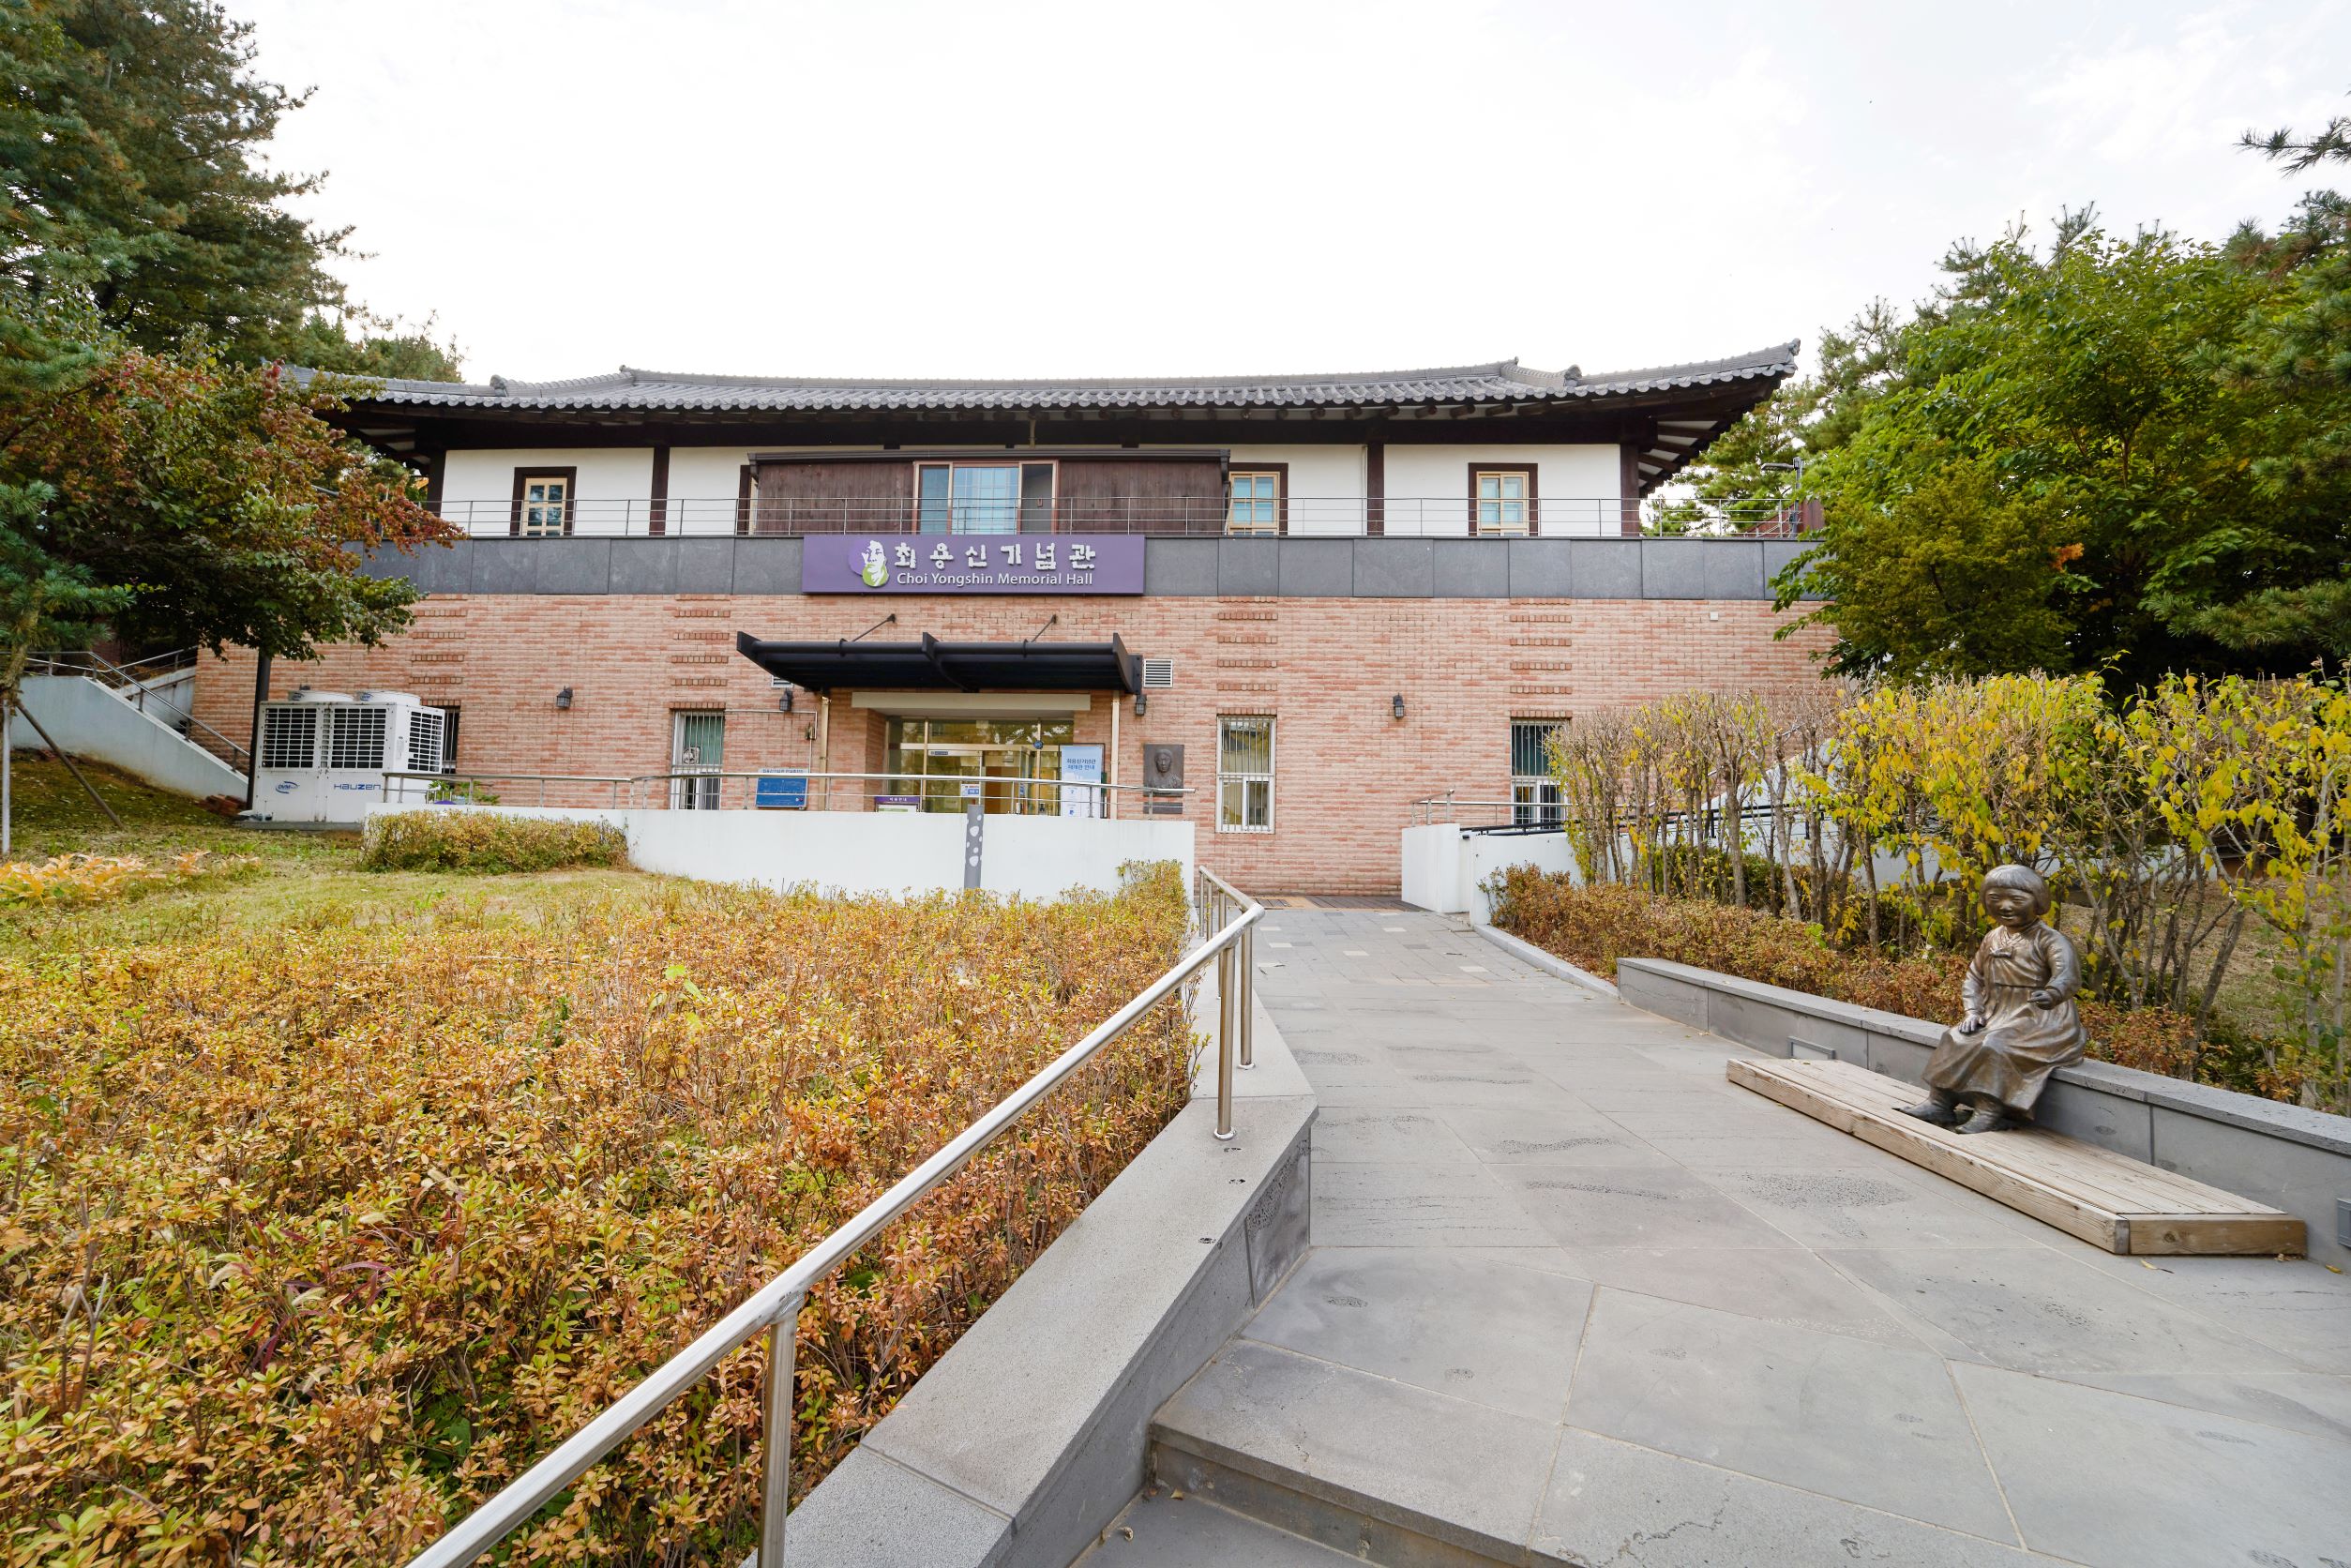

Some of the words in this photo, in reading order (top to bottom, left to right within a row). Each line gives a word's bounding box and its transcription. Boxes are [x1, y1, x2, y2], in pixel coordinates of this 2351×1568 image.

[895, 542, 1096, 570] 최용신기념관
[897, 572, 927, 585] Choi
[931, 572, 993, 588] Yongshin
[998, 573, 1062, 586] Memorial
[1066, 573, 1093, 585] Hall
